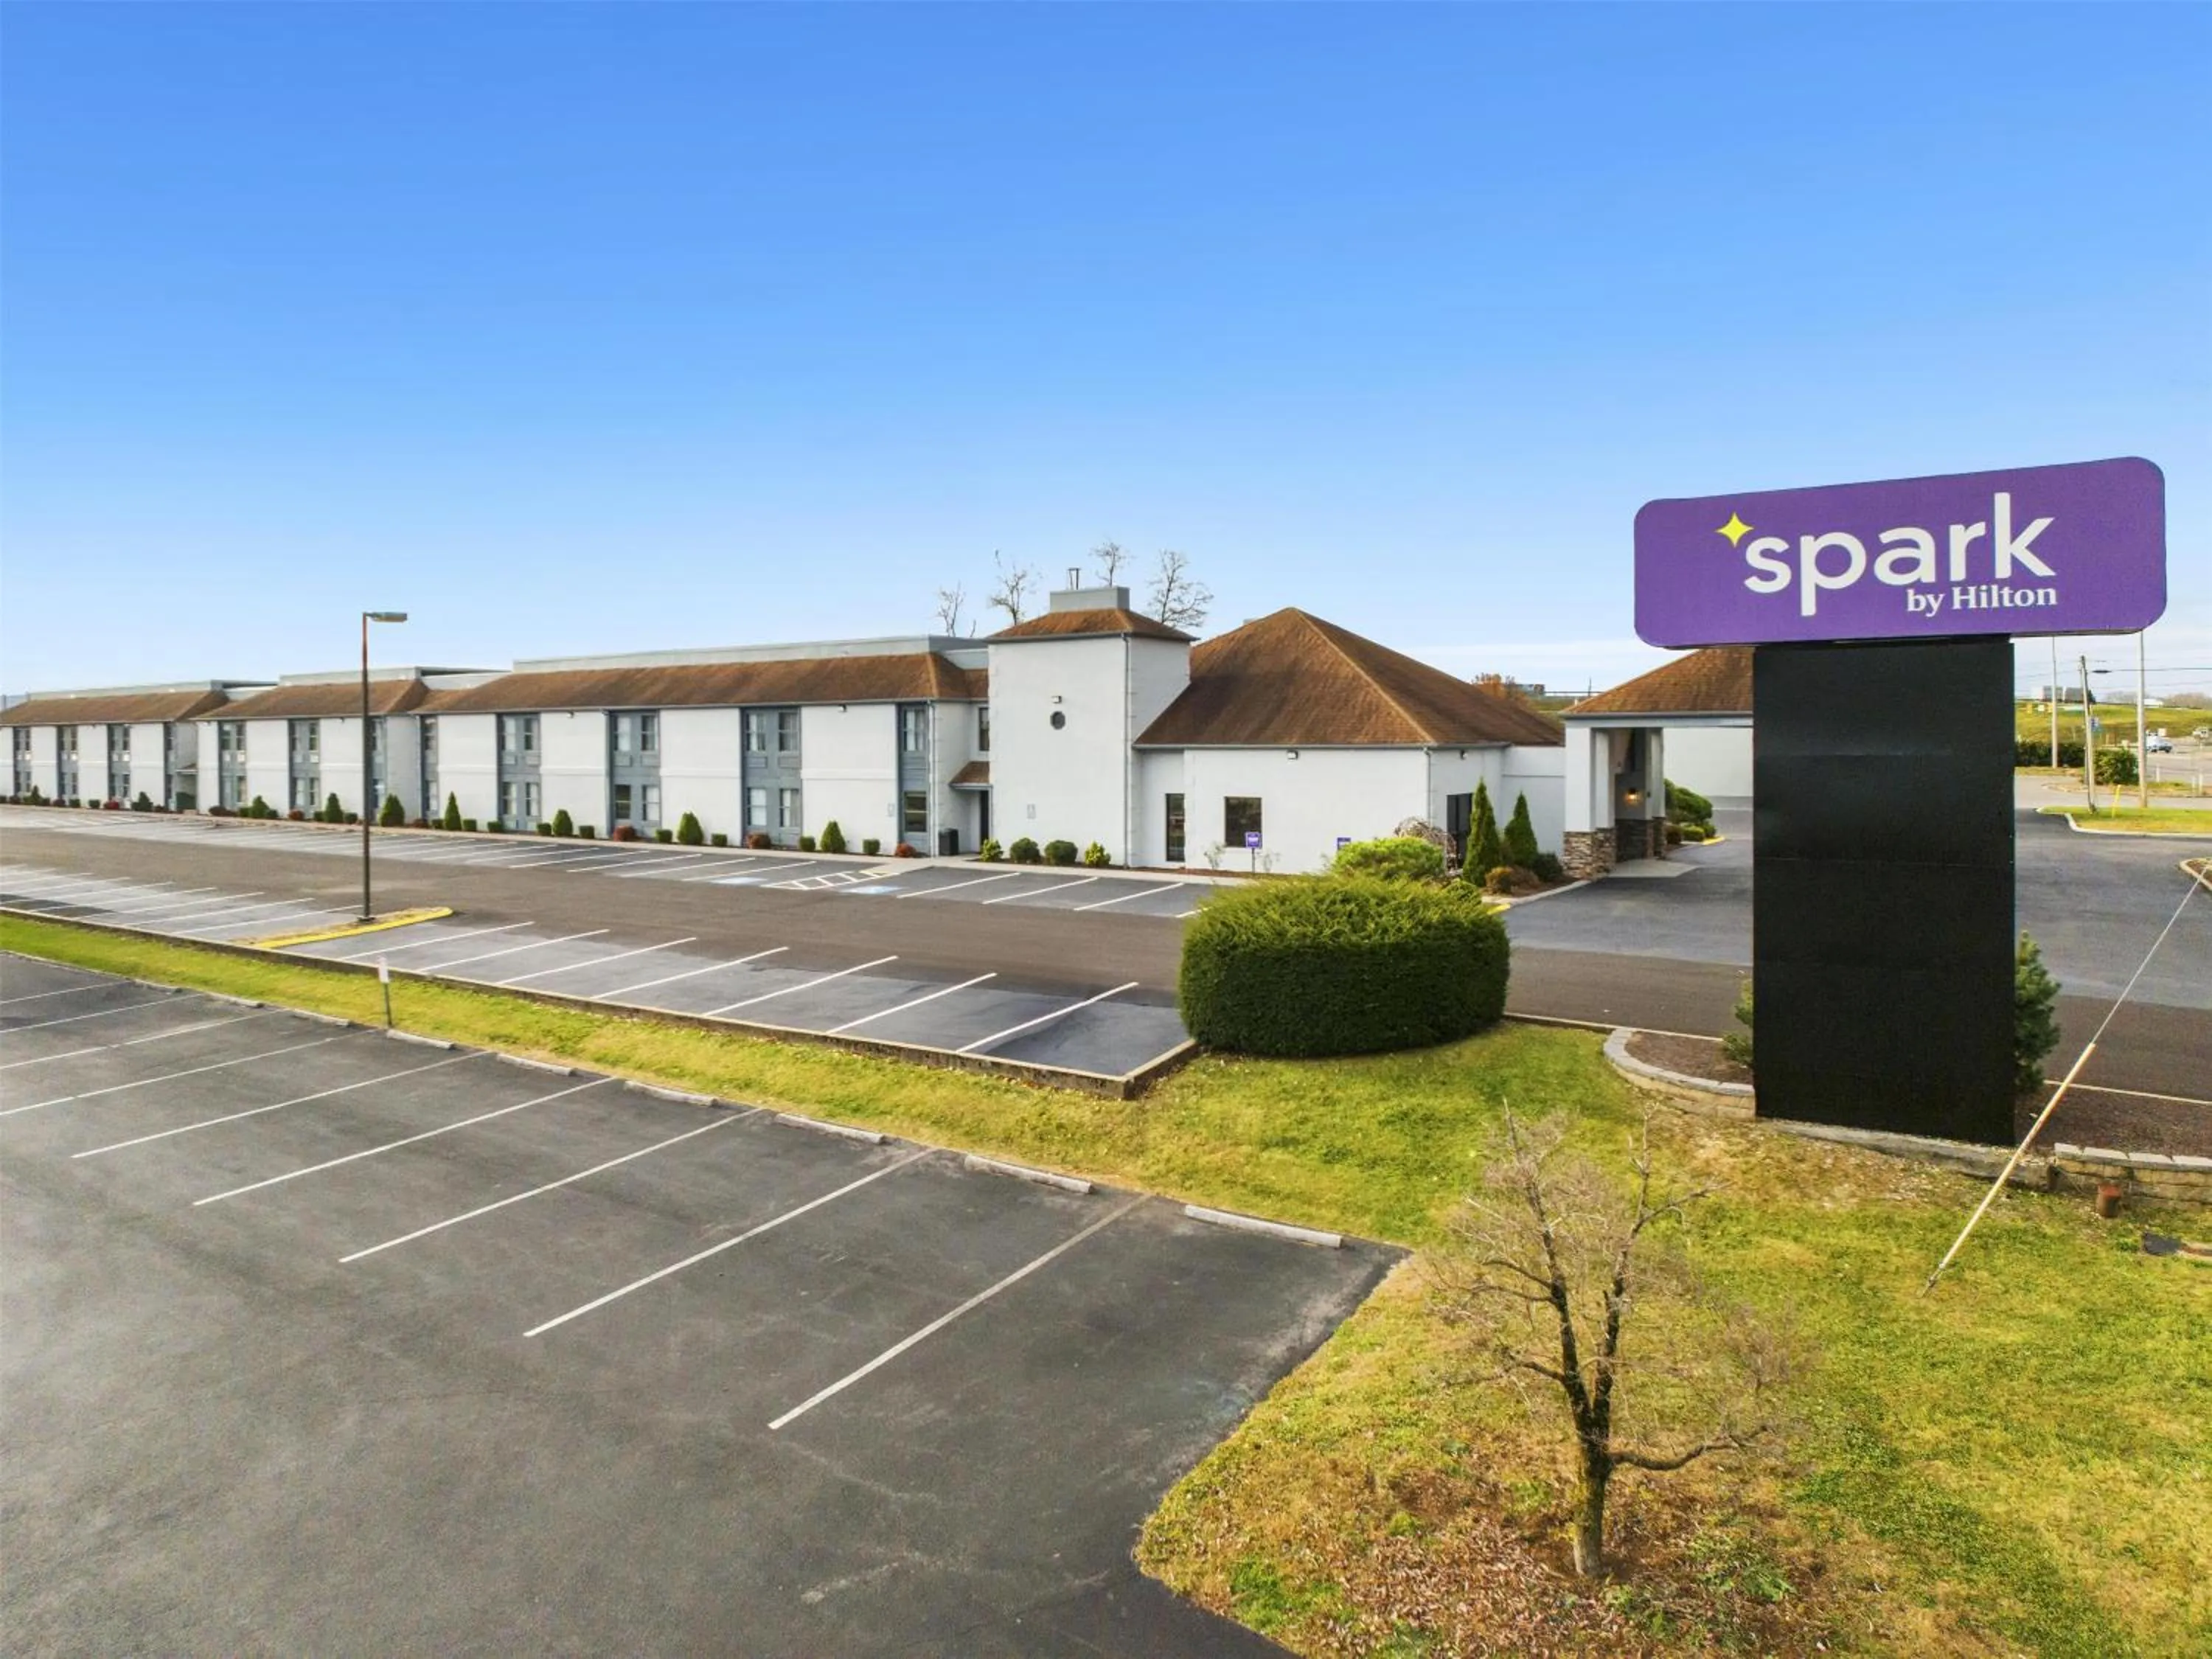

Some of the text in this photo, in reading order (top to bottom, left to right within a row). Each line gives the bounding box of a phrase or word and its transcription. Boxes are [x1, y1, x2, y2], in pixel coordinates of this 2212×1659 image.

[1744, 492, 2056, 616] spark
[1907, 585, 2057, 618] by Hilton
